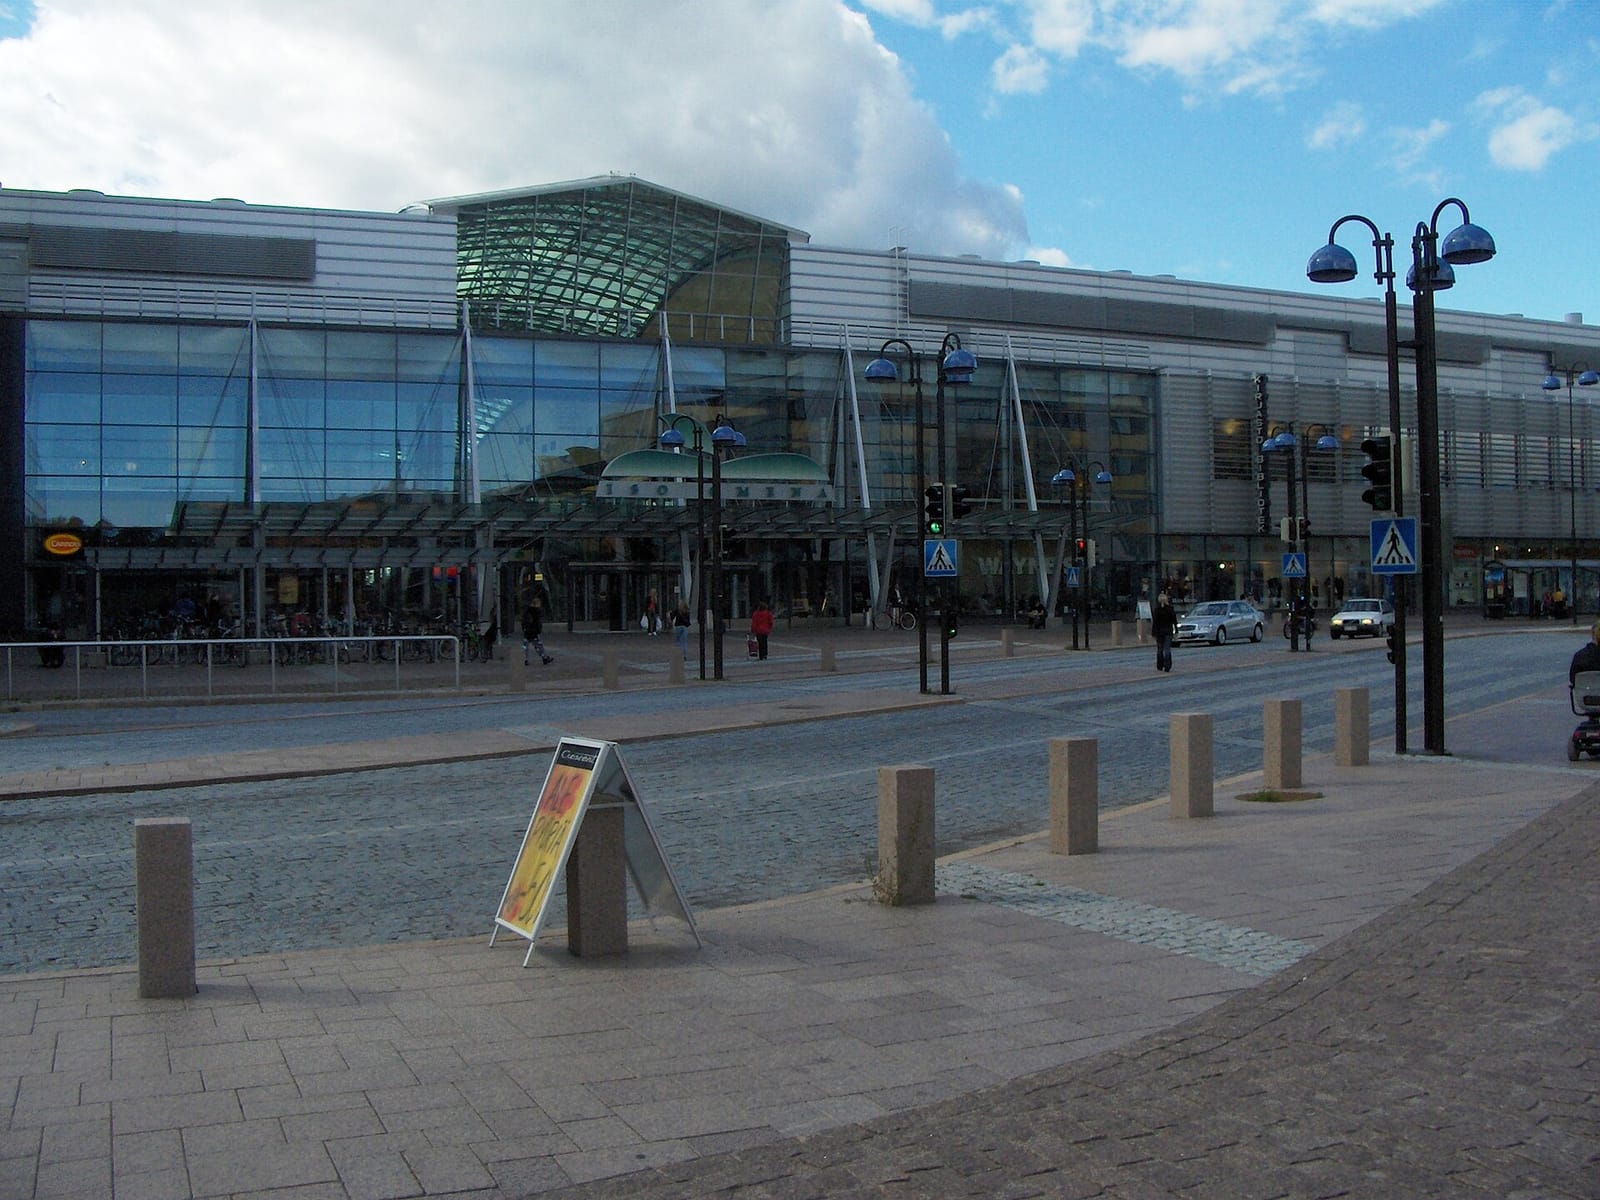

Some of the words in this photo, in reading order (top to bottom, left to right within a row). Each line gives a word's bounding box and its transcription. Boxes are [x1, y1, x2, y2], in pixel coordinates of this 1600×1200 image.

[1254, 375, 1264, 444] KIRJASTO
[606, 483, 668, 496] ISO
[1256, 455, 1265, 533] BIBLIOTEK
